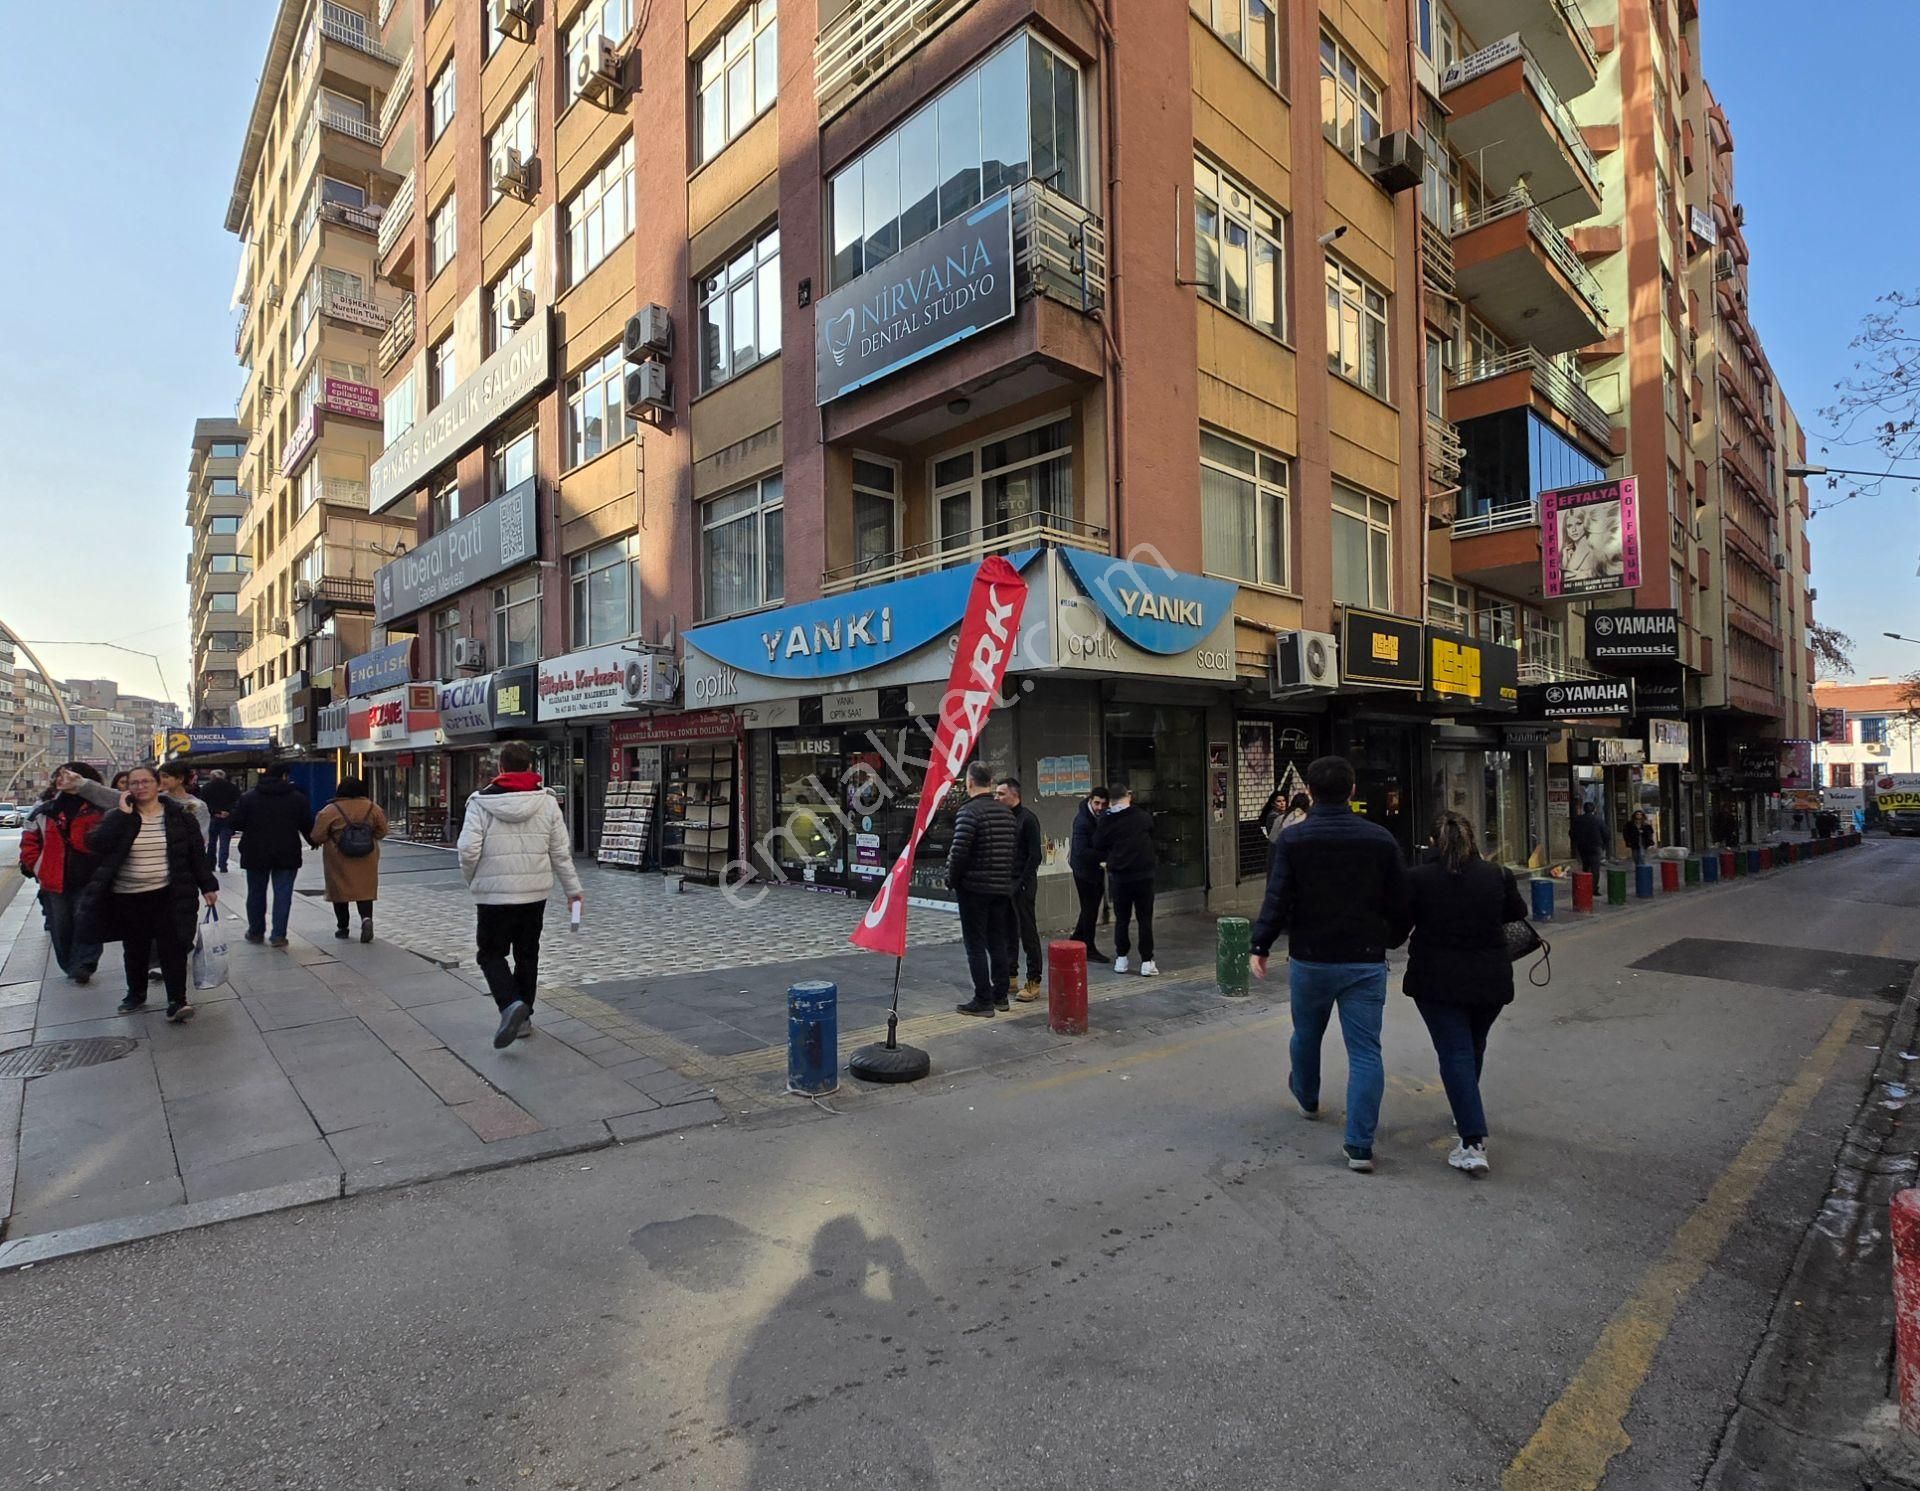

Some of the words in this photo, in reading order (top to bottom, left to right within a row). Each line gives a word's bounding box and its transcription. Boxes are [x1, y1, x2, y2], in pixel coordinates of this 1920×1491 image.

[861, 237, 992, 332] NİRVANA
[333, 302, 363, 316] Nurettin
[365, 311, 386, 322] TUNA
[860, 317, 920, 357] DENTAL
[924, 273, 995, 328] STÜDYO
[482, 328, 543, 401] SALONU
[332, 382, 358, 392] esmer
[360, 388, 374, 397] life
[332, 389, 374, 403] epilasyon
[1560, 488, 1619, 507] EFTALYA
[1546, 498, 1558, 593] COIFFEUR
[1624, 484, 1637, 582] COIFFEUR
[402, 540, 442, 590] Liberal
[449, 516, 482, 567] Parti
[417, 581, 437, 603] Genel
[438, 567, 465, 594] Merkezi
[1615, 616, 1676, 634] YAMAHA
[1069, 631, 1117, 660] optik
[1597, 644, 1675, 656] panmusic
[350, 655, 408, 684] ENGLISH
[1197, 649, 1230, 670] saat
[441, 681, 487, 711] ECEM
[695, 667, 737, 704] optik
[1565, 684, 1628, 701] YAMAHA
[1545, 704, 1630, 716] panmusic
[677, 727, 698, 736] TONER
[699, 724, 728, 735] DOLUMU
[799, 740, 831, 755] LENS
